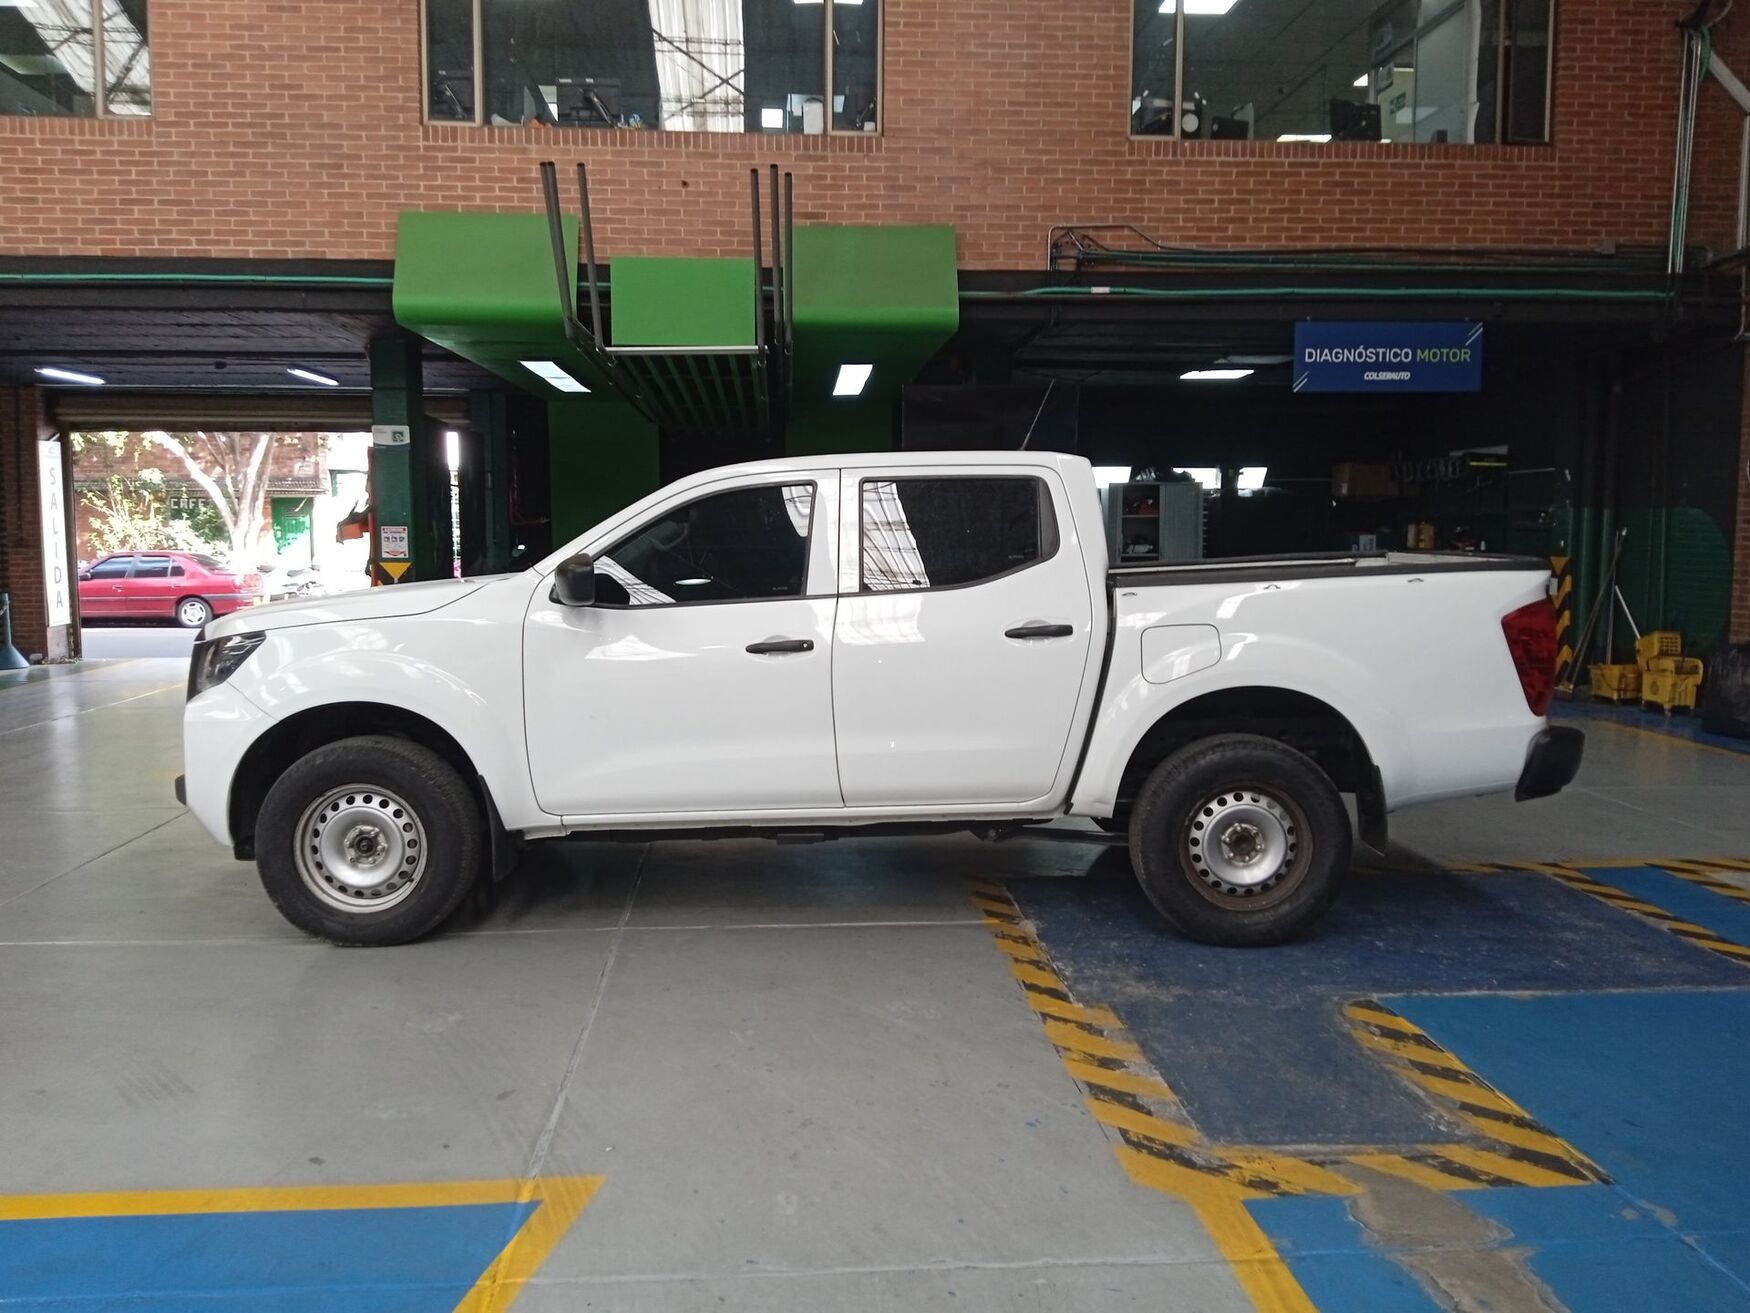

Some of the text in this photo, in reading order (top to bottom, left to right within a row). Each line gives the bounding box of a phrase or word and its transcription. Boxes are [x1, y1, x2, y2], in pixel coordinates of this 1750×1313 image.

[1304, 345, 1472, 363] DIAGNÓSTICO MOTOR
[170, 498, 210, 509] CAFE
[48, 466, 64, 609] SALIDA
